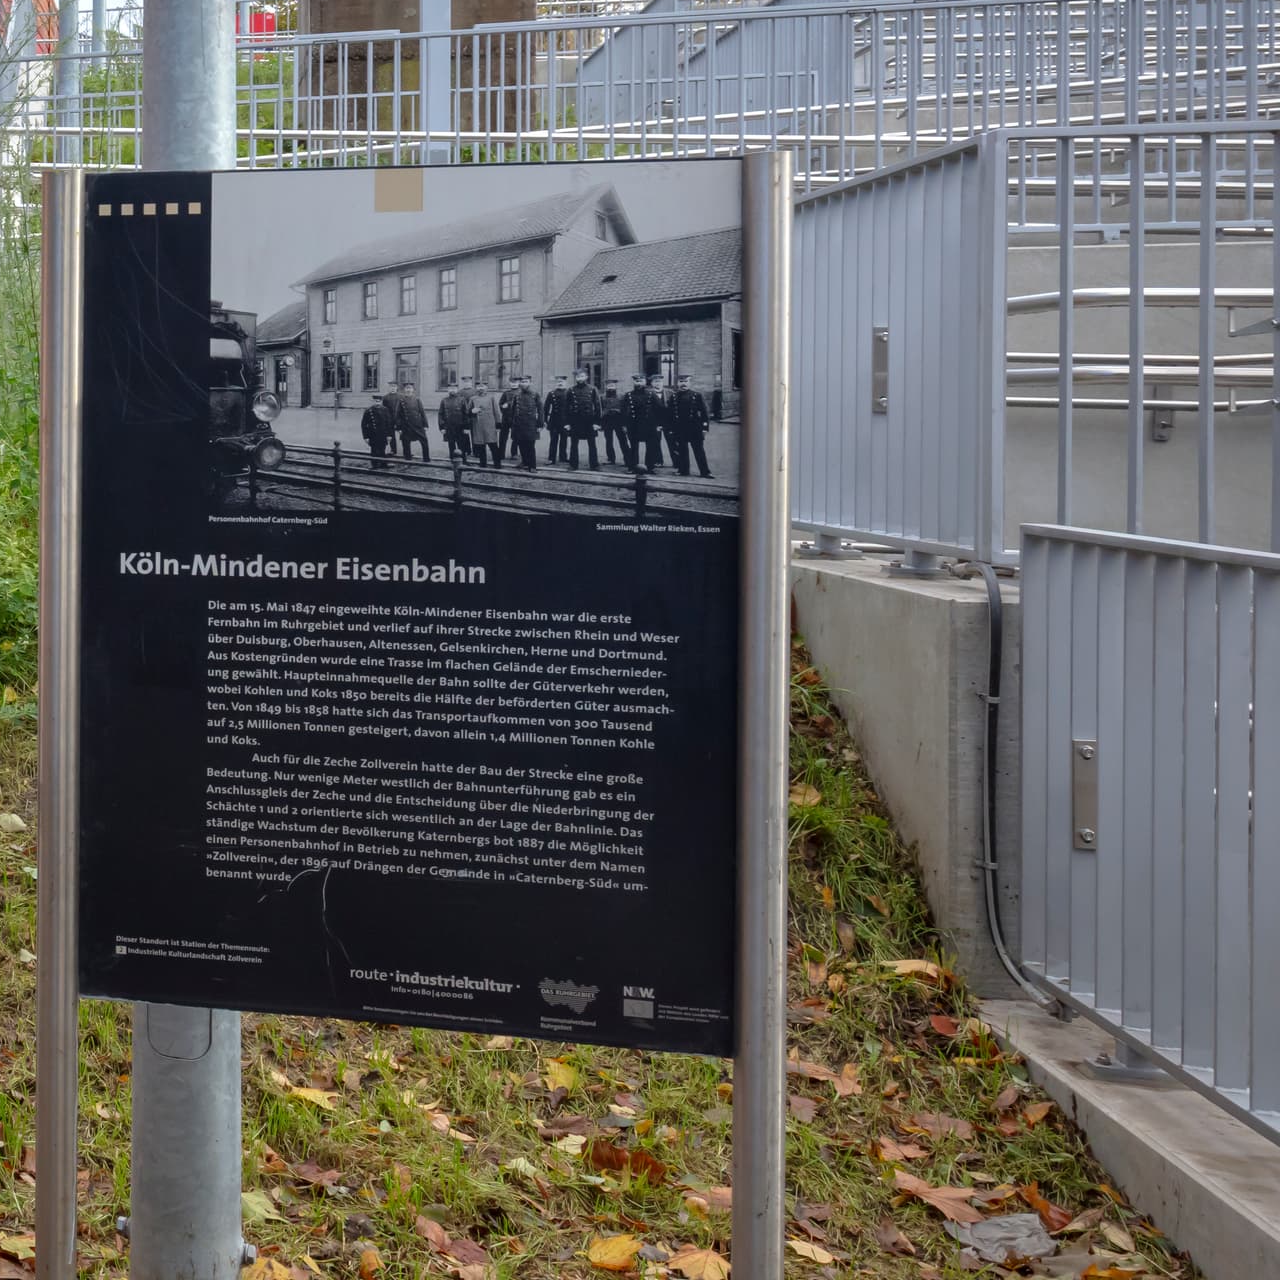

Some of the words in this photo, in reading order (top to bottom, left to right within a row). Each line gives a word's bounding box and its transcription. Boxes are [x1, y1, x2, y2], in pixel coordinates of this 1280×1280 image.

[596, 523, 639, 533] Sammlung
[639, 524, 667, 532] Walter
[667, 524, 697, 533] Rieken,
[697, 525, 720, 533] Essen
[120, 552, 328, 579] Köln-Mindener
[336, 557, 486, 584] Eisenbahn
[208, 599, 227, 610] Die
[229, 602, 247, 611] am
[250, 603, 264, 613] 15.
[266, 602, 288, 612] Mai
[290, 602, 316, 615] 1847
[318, 603, 391, 617] eingeweihte
[394, 605, 483, 618] Köln-Mindener
[485, 608, 548, 621] Eisenbahn
[551, 613, 575, 622] war
[577, 611, 597, 623] die
[600, 613, 632, 624] erste
[207, 616, 260, 628] Fernbahn
[263, 618, 278, 629] im
[280, 619, 344, 633] Ruhrgebiet
[347, 621, 370, 632] und
[372, 622, 411, 633] verlief
[412, 623, 434, 634] auf
[436, 624, 465, 635] ihrer
[467, 625, 512, 637] Strecke
[514, 627, 571, 639] zwischen
[574, 629, 609, 641] Rhein
[613, 631, 637, 642] und
[640, 632, 680, 643] Weser
[207, 633, 234, 644] über
[236, 634, 291, 649] Duisburg,
[293, 636, 367, 650] Oberhausen,
[368, 639, 437, 653] Altenessen,
[439, 641, 528, 656] Gelsenkirchen,
[530, 645, 568, 657] Herne
[571, 647, 595, 658] und
[598, 648, 667, 661] Dortmund.
[207, 650, 228, 661] Aus
[231, 651, 317, 665] Kostengründen
[320, 655, 357, 665] wurde
[359, 656, 385, 667] eine
[387, 657, 424, 668] Trasse
[426, 658, 442, 669] im
[444, 658, 490, 671] flachen
[492, 661, 543, 673] Gelände
[546, 663, 567, 674] der
[570, 664, 667, 678] Emschernieder-
[207, 669, 229, 680] ung
[231, 668, 282, 681] gewählt.
[284, 670, 414, 686] Haupteinnahmequelle
[416, 675, 437, 686] der
[439, 676, 470, 687] Bahn
[472, 678, 506, 689] sollte
[509, 679, 530, 690] der
[532, 680, 615, 694] Güterverkehr
[617, 685, 669, 698] werden,
[206, 683, 241, 694] wobei
[244, 685, 283, 696] Kohlen
[286, 687, 308, 697] und
[311, 688, 338, 699] Koks
[340, 689, 367, 702] 1850
[370, 690, 410, 702] bereits
[413, 692, 432, 703] die
[434, 693, 472, 705] Hälfte
[474, 695, 495, 706] der
[498, 695, 571, 710] beförderten
[574, 700, 610, 712] Güter
[612, 703, 675, 714] ausmach-
[207, 700, 229, 711] ten.
[230, 701, 253, 712] Von
[255, 702, 282, 715] 1849
[284, 703, 301, 714] bis
[303, 704, 329, 717] 1858
[332, 705, 364, 717] hatte
[366, 707, 389, 718] sich
[392, 708, 413, 719] das
[414, 710, 545, 726] Transportaufkommen
[548, 718, 571, 727] von
[574, 719, 598, 730] 300
[600, 719, 653, 732] Tausend
[206, 734, 228, 744] und
[231, 735, 261, 746] Koks.
[128, 947, 167, 957] Industrielle
[168, 950, 226, 961] Kulturlandschaft
[227, 954, 262, 964] Zollverein
